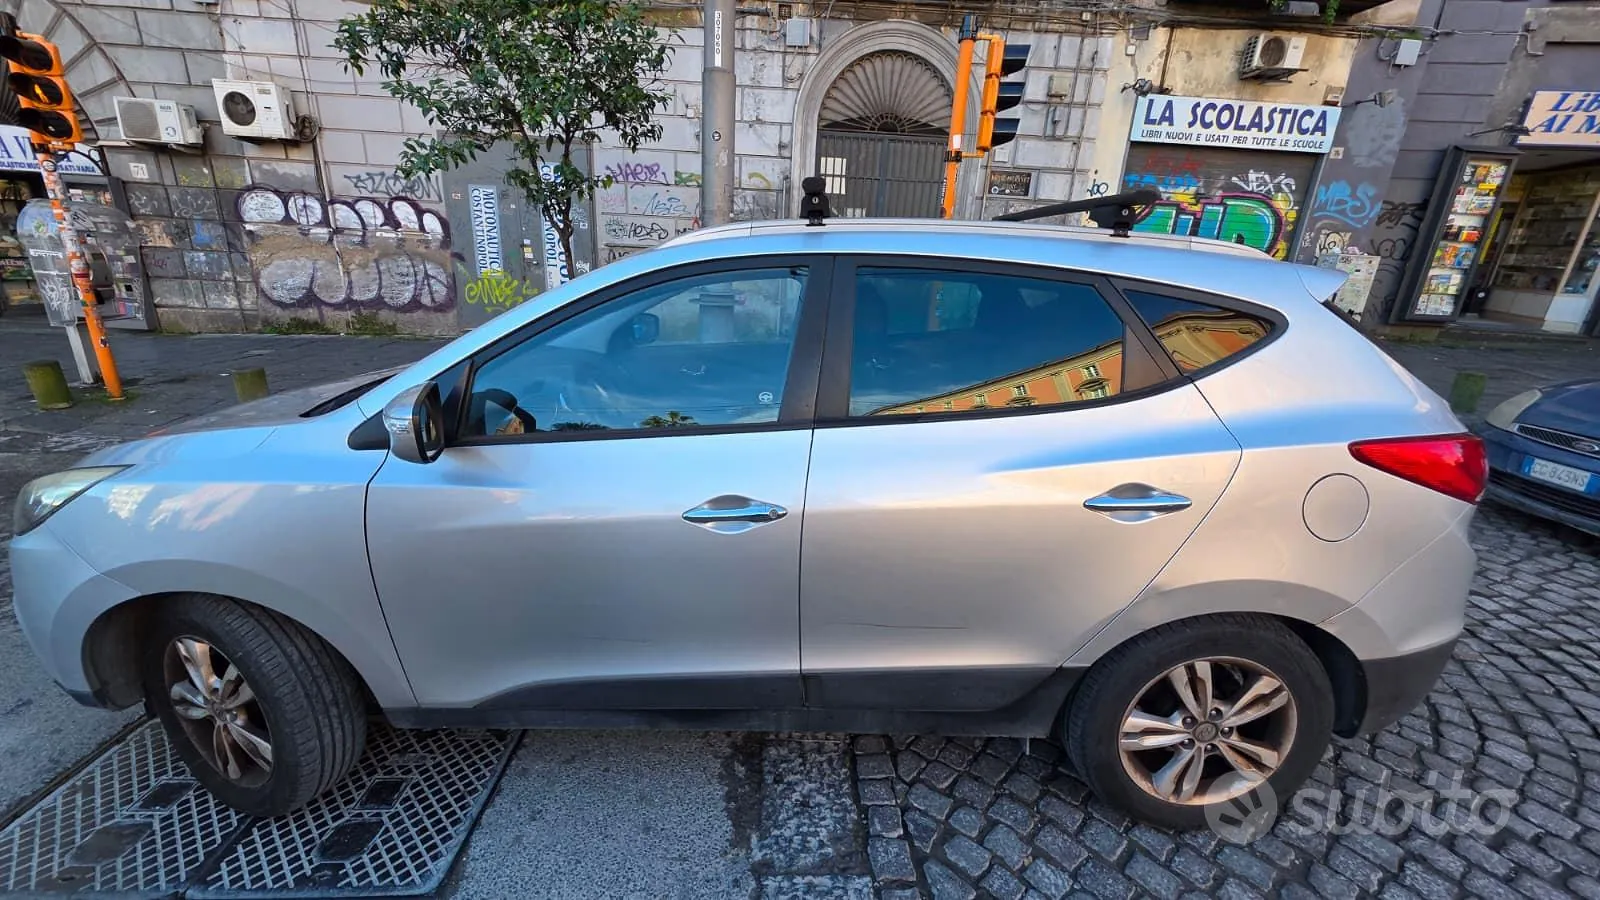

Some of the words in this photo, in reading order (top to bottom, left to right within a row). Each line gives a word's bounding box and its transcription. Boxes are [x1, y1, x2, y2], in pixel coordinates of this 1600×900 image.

[1143, 99, 1175, 126] LA
[1188, 101, 1327, 137] SCOLASTICA
[1141, 129, 1162, 139] LIBRI
[1165, 131, 1192, 141] NUOVI
[1196, 133, 1202, 142] E
[1205, 134, 1229, 143] USATI
[1232, 135, 1248, 145] PER
[1251, 136, 1276, 147] TUTTE
[1279, 138, 1289, 147] LE
[1292, 139, 1325, 149] SCUOLE
